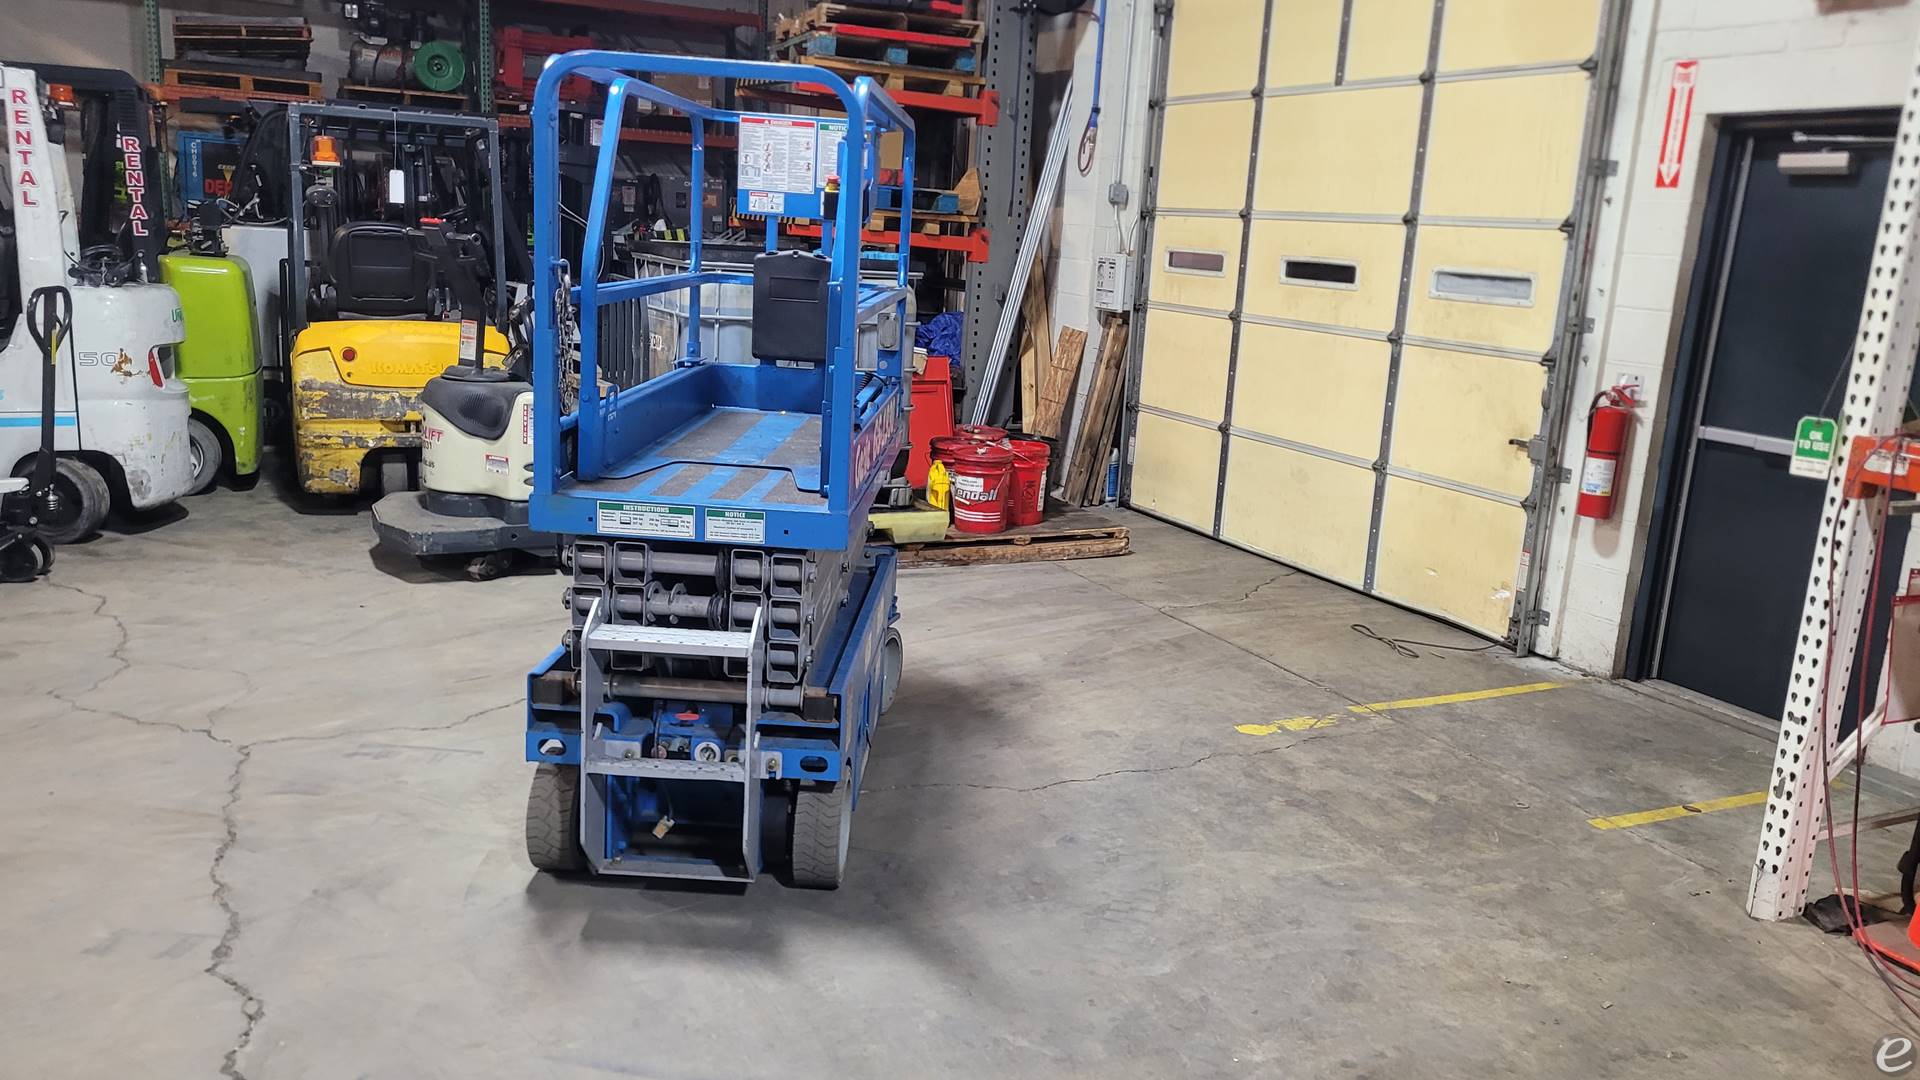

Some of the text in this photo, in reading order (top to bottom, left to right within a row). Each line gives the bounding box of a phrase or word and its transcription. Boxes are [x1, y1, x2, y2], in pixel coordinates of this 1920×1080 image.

[11, 88, 37, 207] RENTAL
[122, 136, 149, 237] RENTAL
[79, 351, 119, 367] 50
[623, 504, 670, 514] INSTRUCTIONS
